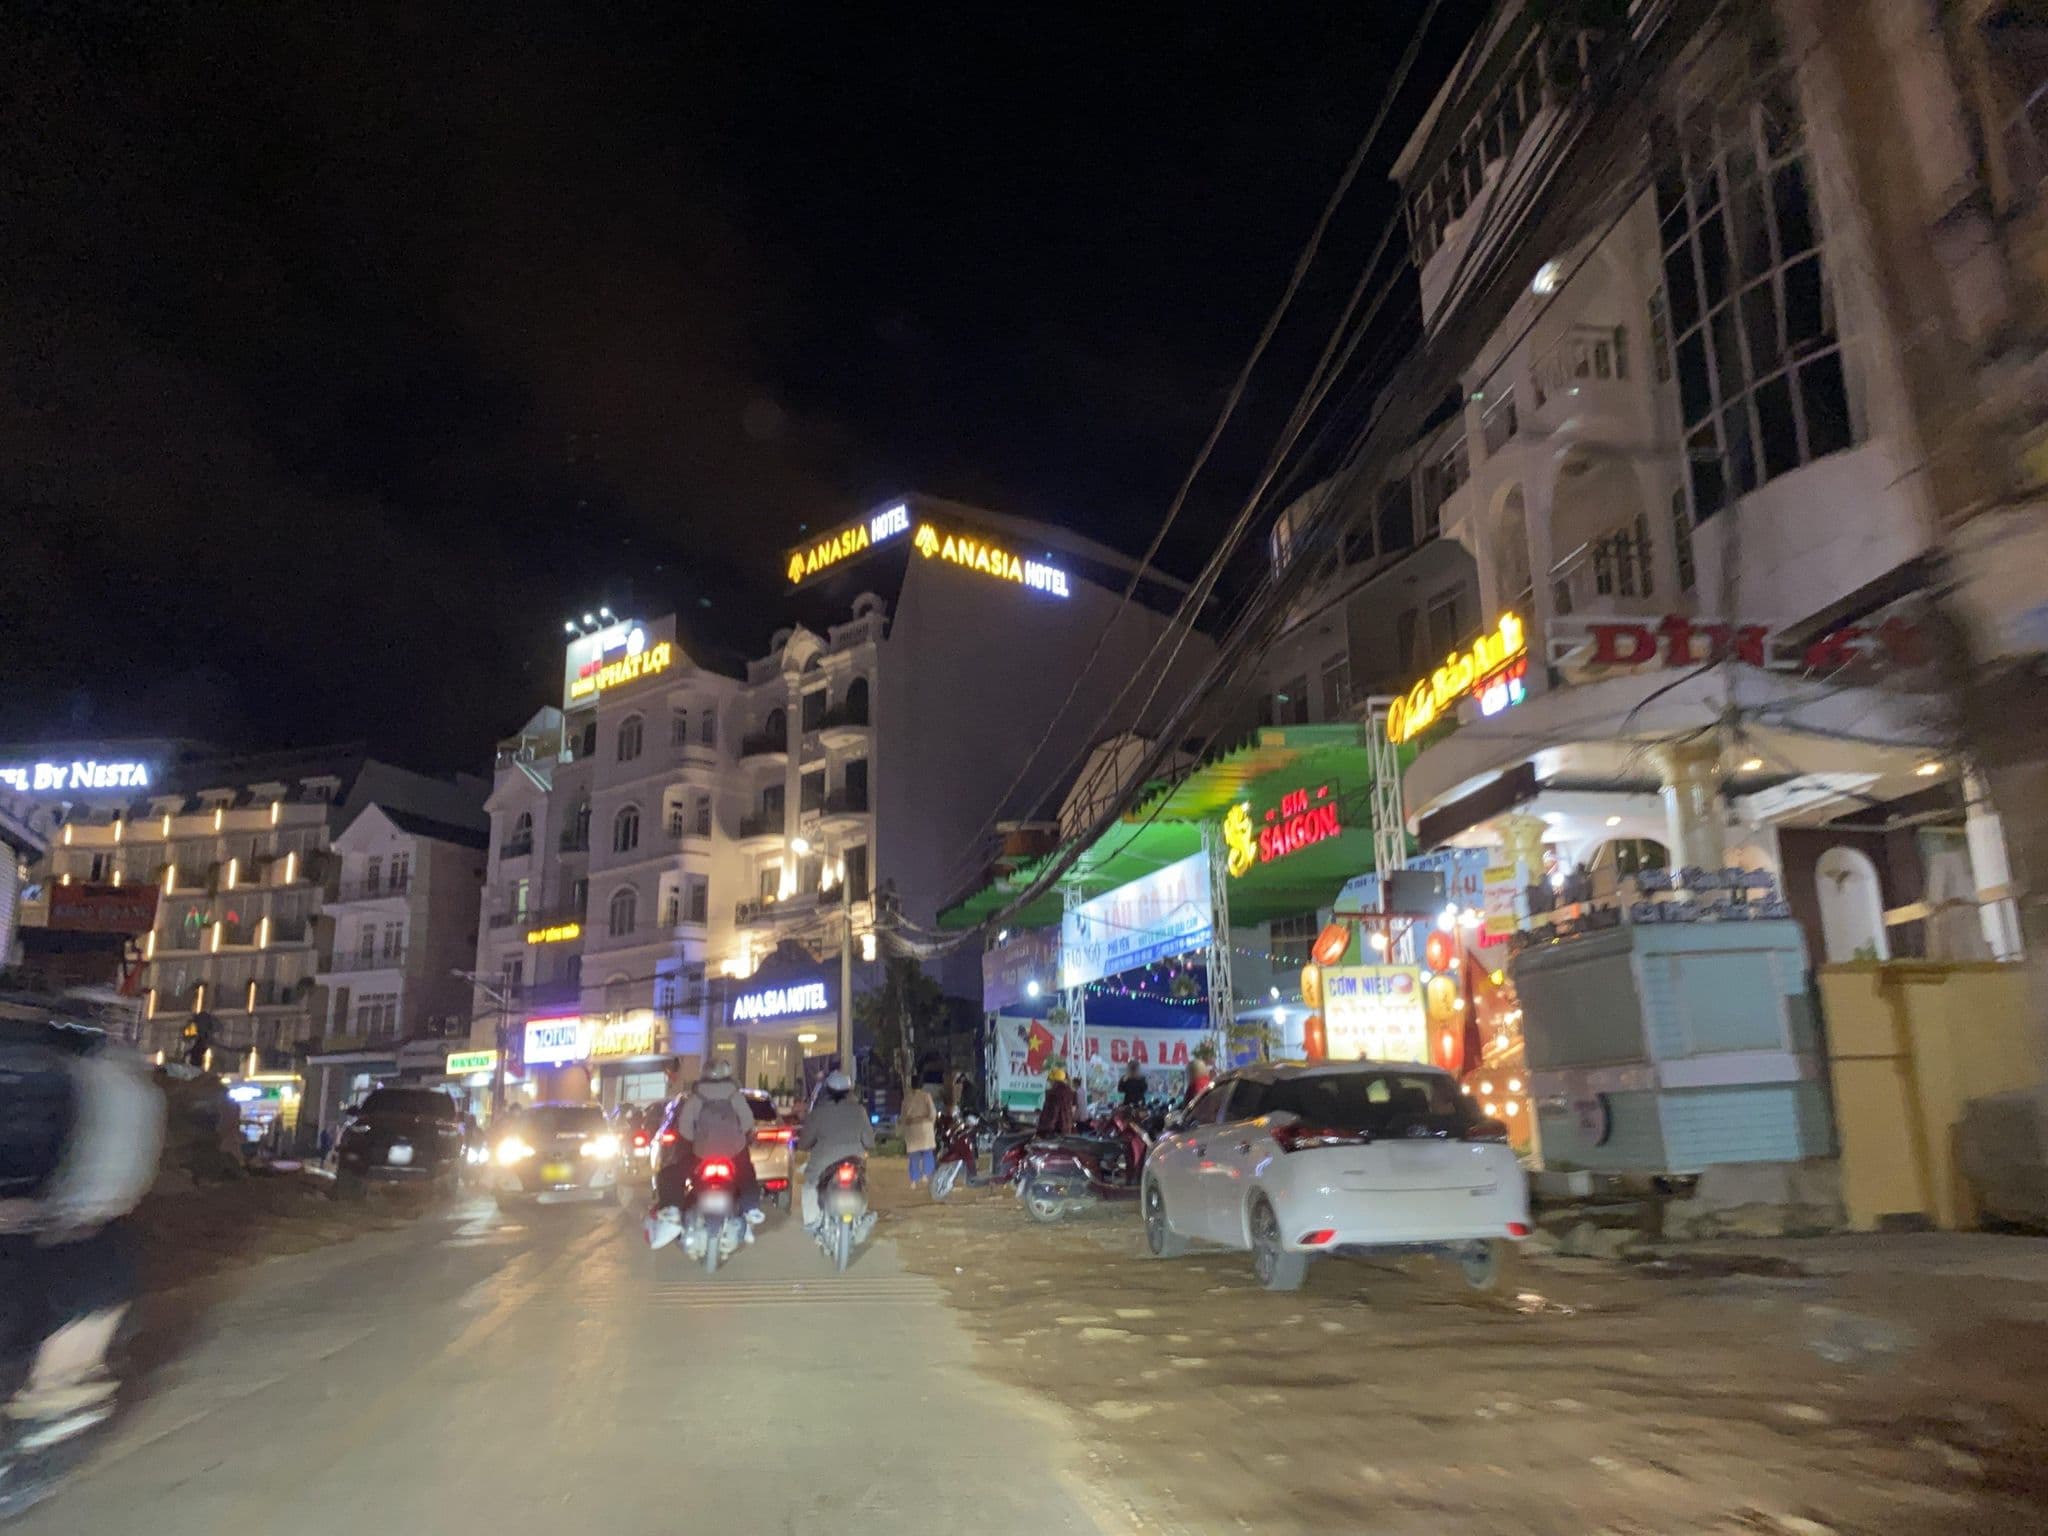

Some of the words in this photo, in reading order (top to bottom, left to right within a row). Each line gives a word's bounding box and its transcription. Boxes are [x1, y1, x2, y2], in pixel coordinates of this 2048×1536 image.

[806, 523, 869, 575] ANASIA
[871, 503, 909, 543] HOTEL
[941, 534, 1023, 583] ANASIA
[1024, 559, 1069, 597] HOTEL
[1282, 788, 1309, 818] BIA
[733, 988, 787, 1020] ANASIA
[786, 982, 828, 1013] HOTEL
[1111, 1034, 1149, 1066] GÀ
[1159, 1036, 1190, 1066] LÁ
